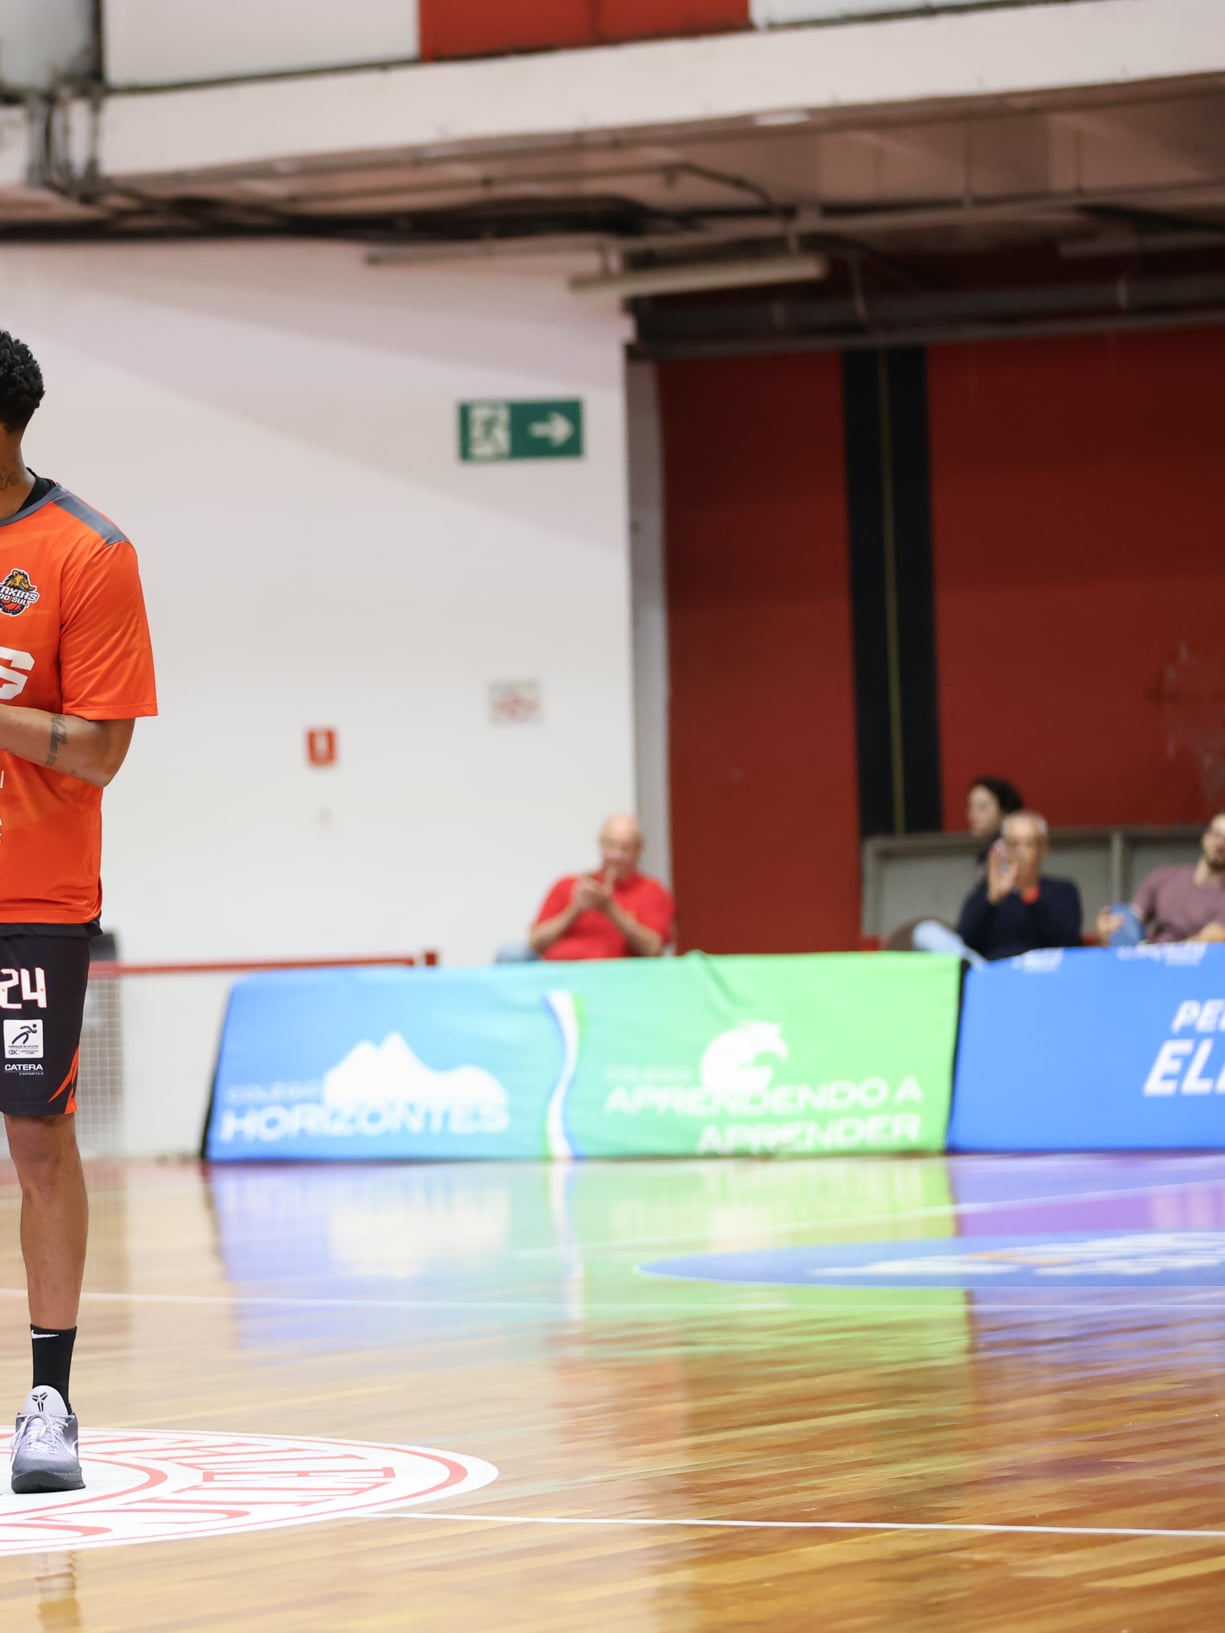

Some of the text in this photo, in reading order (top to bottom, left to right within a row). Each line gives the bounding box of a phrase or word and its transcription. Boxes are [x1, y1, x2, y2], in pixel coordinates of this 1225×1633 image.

[1172, 999, 1225, 1034] PE
[4, 1063, 44, 1071] CATERA
[1143, 1038, 1225, 1097] EL
[893, 1075, 923, 1104] A
[220, 1100, 510, 1143] HORIZONTES
